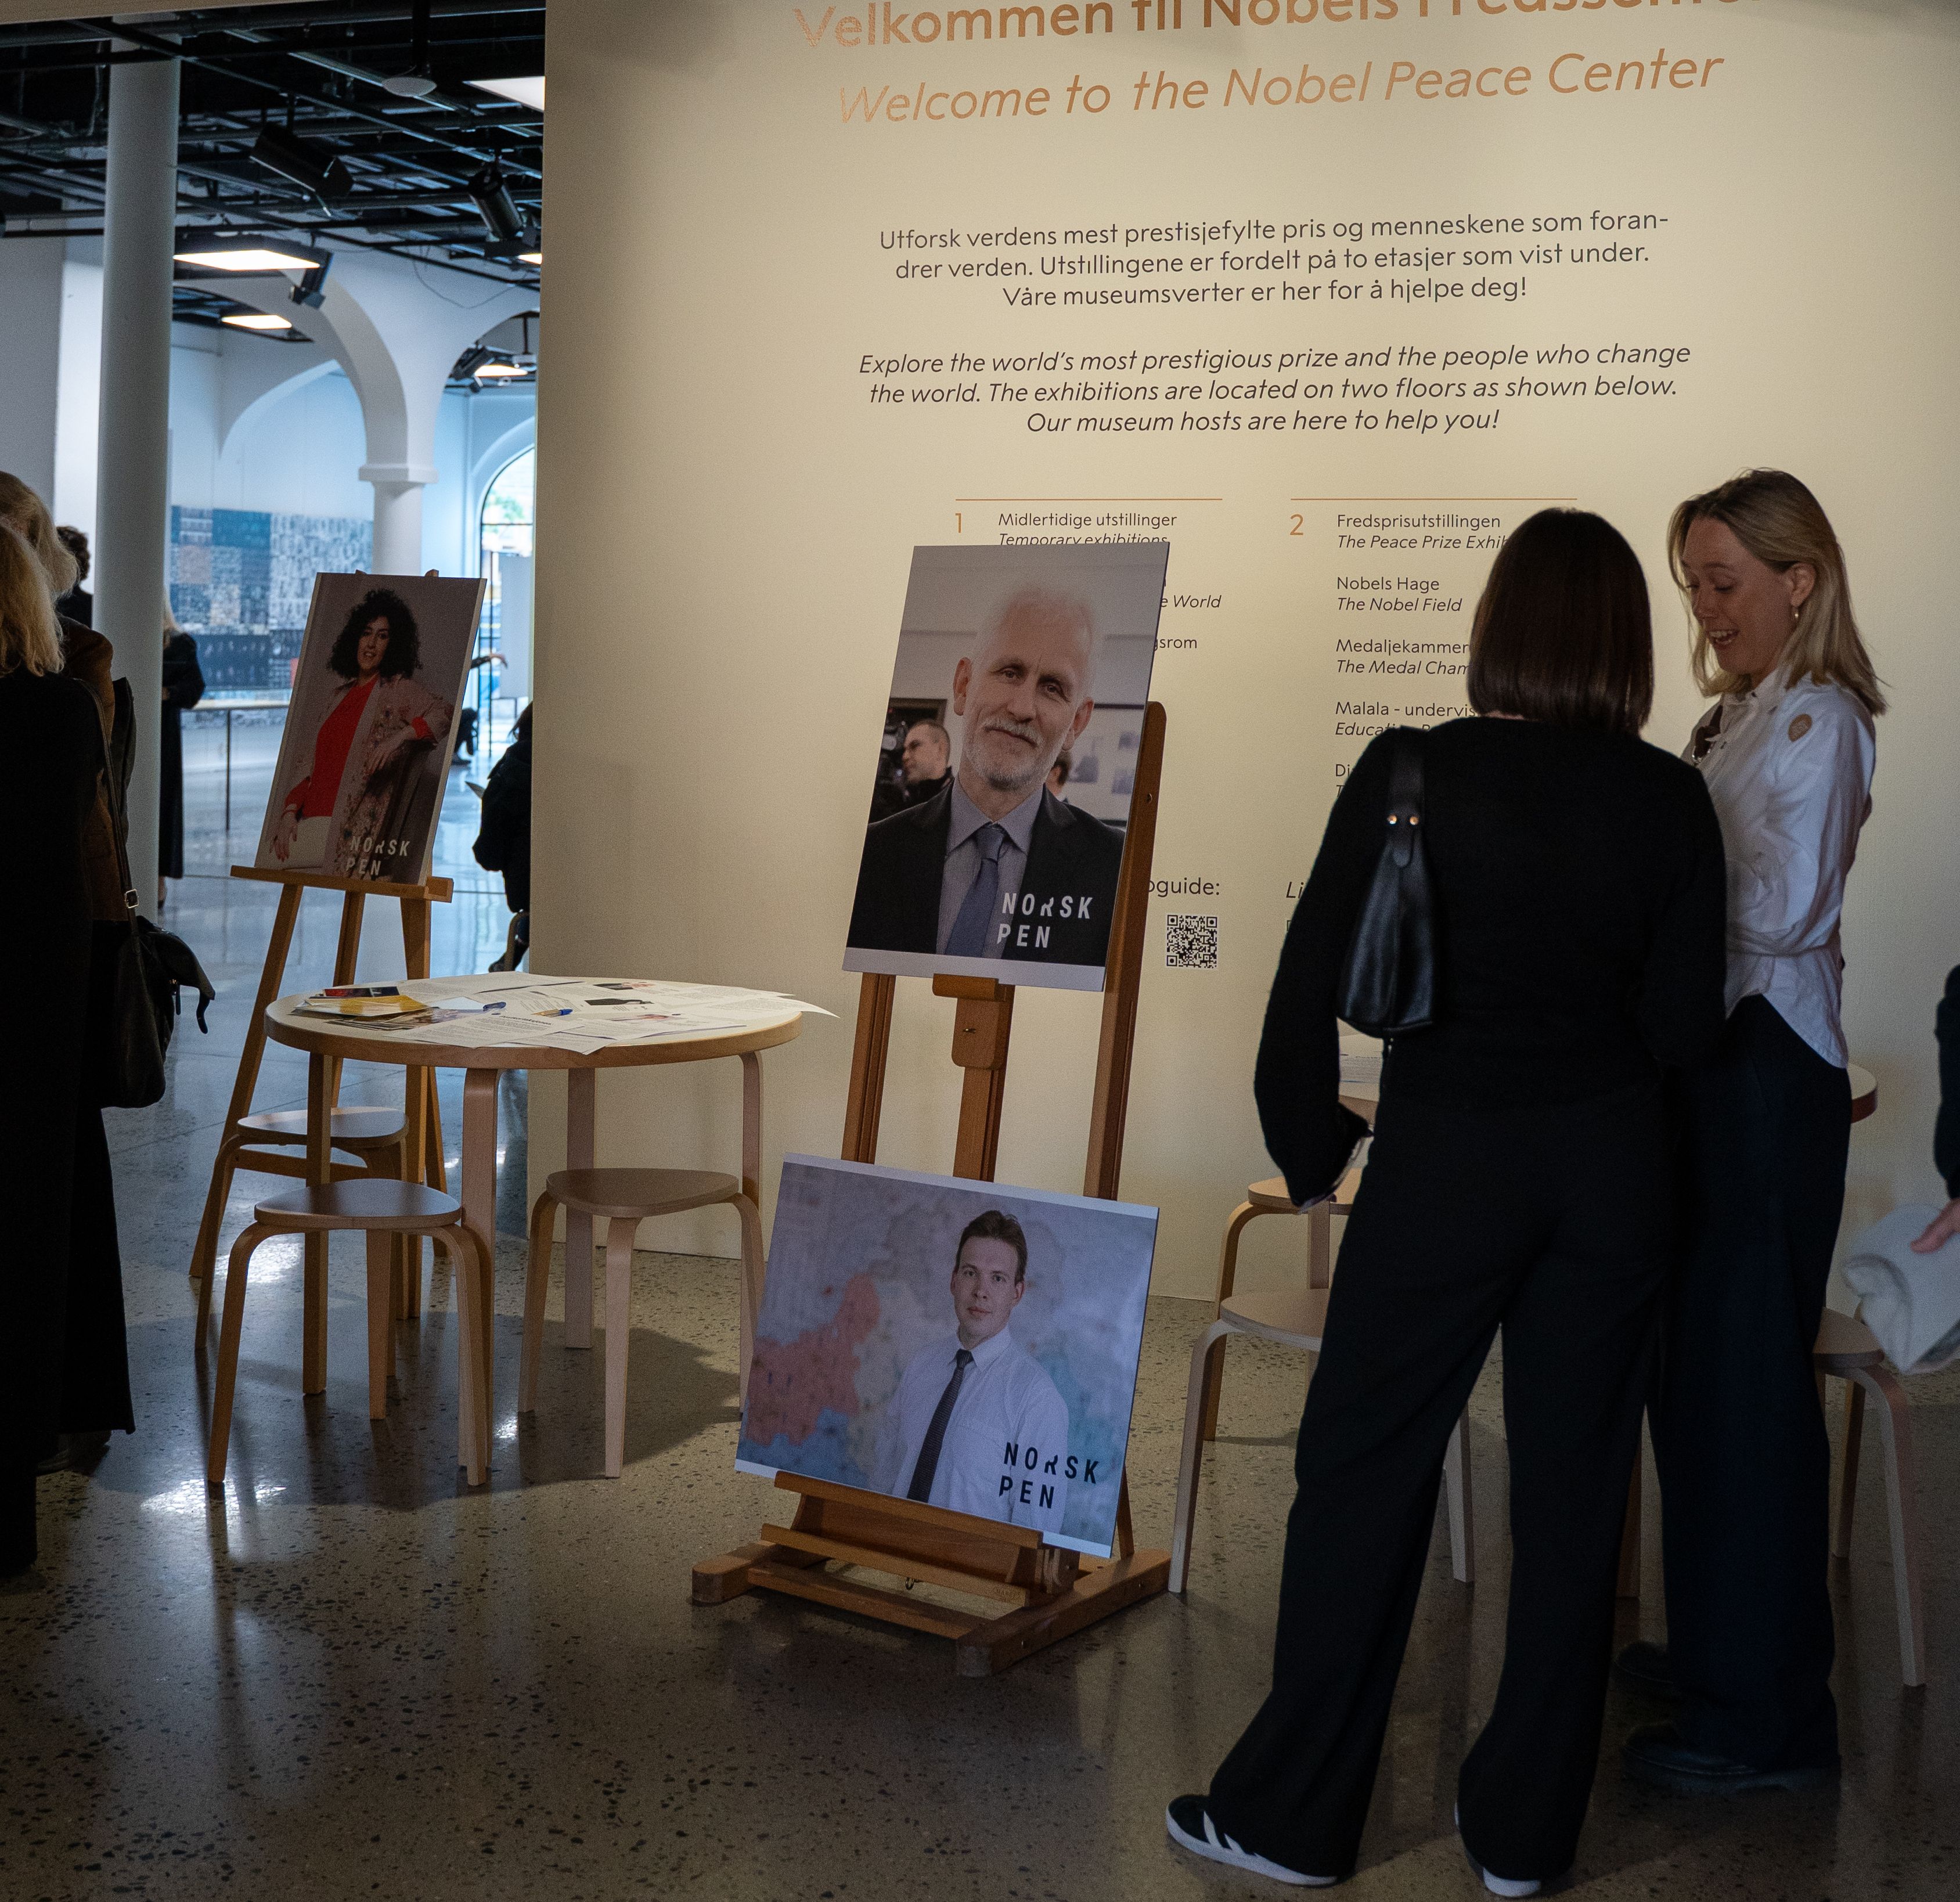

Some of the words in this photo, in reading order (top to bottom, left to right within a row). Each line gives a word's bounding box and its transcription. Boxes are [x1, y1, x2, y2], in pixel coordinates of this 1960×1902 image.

[794, 2, 1113, 47] Velkommen
[841, 83, 1051, 123] Welcome
[1066, 75, 1111, 114] to
[1134, 71, 1208, 110] the
[1224, 62, 1372, 106] Nobel
[1386, 62, 1531, 99] Peace
[1549, 48, 1724, 93] Center
[881, 229, 960, 249] Utforsk
[967, 226, 1057, 246] verdens
[1065, 224, 1118, 244] mest
[1126, 219, 1275, 247] prestisjefylte
[1284, 219, 1325, 243] pris
[1333, 223, 1362, 242] og
[1372, 214, 1524, 236] menneskene
[1532, 217, 1581, 232] som
[1590, 210, 1668, 230] foran-
[896, 260, 943, 279] drer
[948, 257, 1032, 277] verden.
[1042, 254, 1183, 278] Utstillingene
[1190, 257, 1214, 271] er
[1220, 250, 1300, 271] fordelt
[1309, 249, 1335, 273] på
[1344, 248, 1367, 268] to
[1375, 247, 1456, 271] etasjer
[1463, 250, 1512, 265] som
[1519, 243, 1562, 264] vist
[1571, 242, 1648, 263] under.
[1003, 287, 1056, 306] Våre
[1064, 282, 1245, 305] museumsverter
[1252, 287, 1276, 301] er
[1283, 281, 1321, 300] her
[1328, 279, 1363, 300] for
[1370, 279, 1382, 298] å
[1392, 278, 1464, 303] hjelpe
[1472, 277, 1526, 301] deg!
[860, 354, 943, 377] Explore
[951, 353, 985, 372] the
[1080, 350, 1137, 370] most
[1141, 349, 1272, 374] prestigious
[1278, 348, 1338, 372] prize
[1345, 347, 1392, 366] and
[1399, 346, 1436, 366] the
[1442, 345, 1528, 370] people
[1537, 344, 1589, 364] who
[1597, 343, 1690, 368] change
[871, 384, 905, 403] the
[912, 383, 980, 402] world.
[990, 383, 1028, 402] The
[1165, 386, 1202, 399] are
[1209, 379, 1298, 399] located
[1304, 384, 1333, 398] on
[1342, 379, 1388, 398] two
[1396, 377, 1467, 397] floors
[1473, 383, 1498, 397] as
[1505, 376, 1587, 397] shown
[1595, 375, 1676, 395] below.
[1028, 413, 1072, 432] Our
[1077, 417, 1173, 431] museum
[1181, 410, 1241, 430] hosts
[1248, 416, 1286, 430] are
[1293, 410, 1347, 430] here
[1356, 410, 1378, 430] to
[1385, 409, 1437, 434] help
[1444, 409, 1499, 434] you!
[955, 513, 961, 533] 1
[999, 513, 1091, 529] Midlertidige
[1097, 513, 1177, 529] utstillinger
[1291, 514, 1303, 535] 2
[1338, 514, 1500, 531] Fredsprisutstillingen
[1339, 535, 1365, 548] The
[1371, 535, 1417, 548] Peace
[1422, 535, 1461, 548] Prize
[1338, 577, 1392, 590] Nobels
[1397, 577, 1439, 594] Hage
[1174, 595, 1222, 608] World
[1338, 597, 1365, 610] The
[1370, 597, 1419, 611] Nobel
[1423, 598, 1462, 611] Field
[1338, 660, 1364, 673] The
[1368, 661, 1421, 673] Medal
[1336, 701, 1389, 715] Malala
[1405, 703, 1475, 717] undervis
[1335, 722, 1383, 736] Educa
[1001, 892, 1093, 920] NORSK
[996, 924, 1051, 949] PEN
[1004, 1442, 1099, 1484] NORSK
[999, 1475, 1054, 1509] PEN
